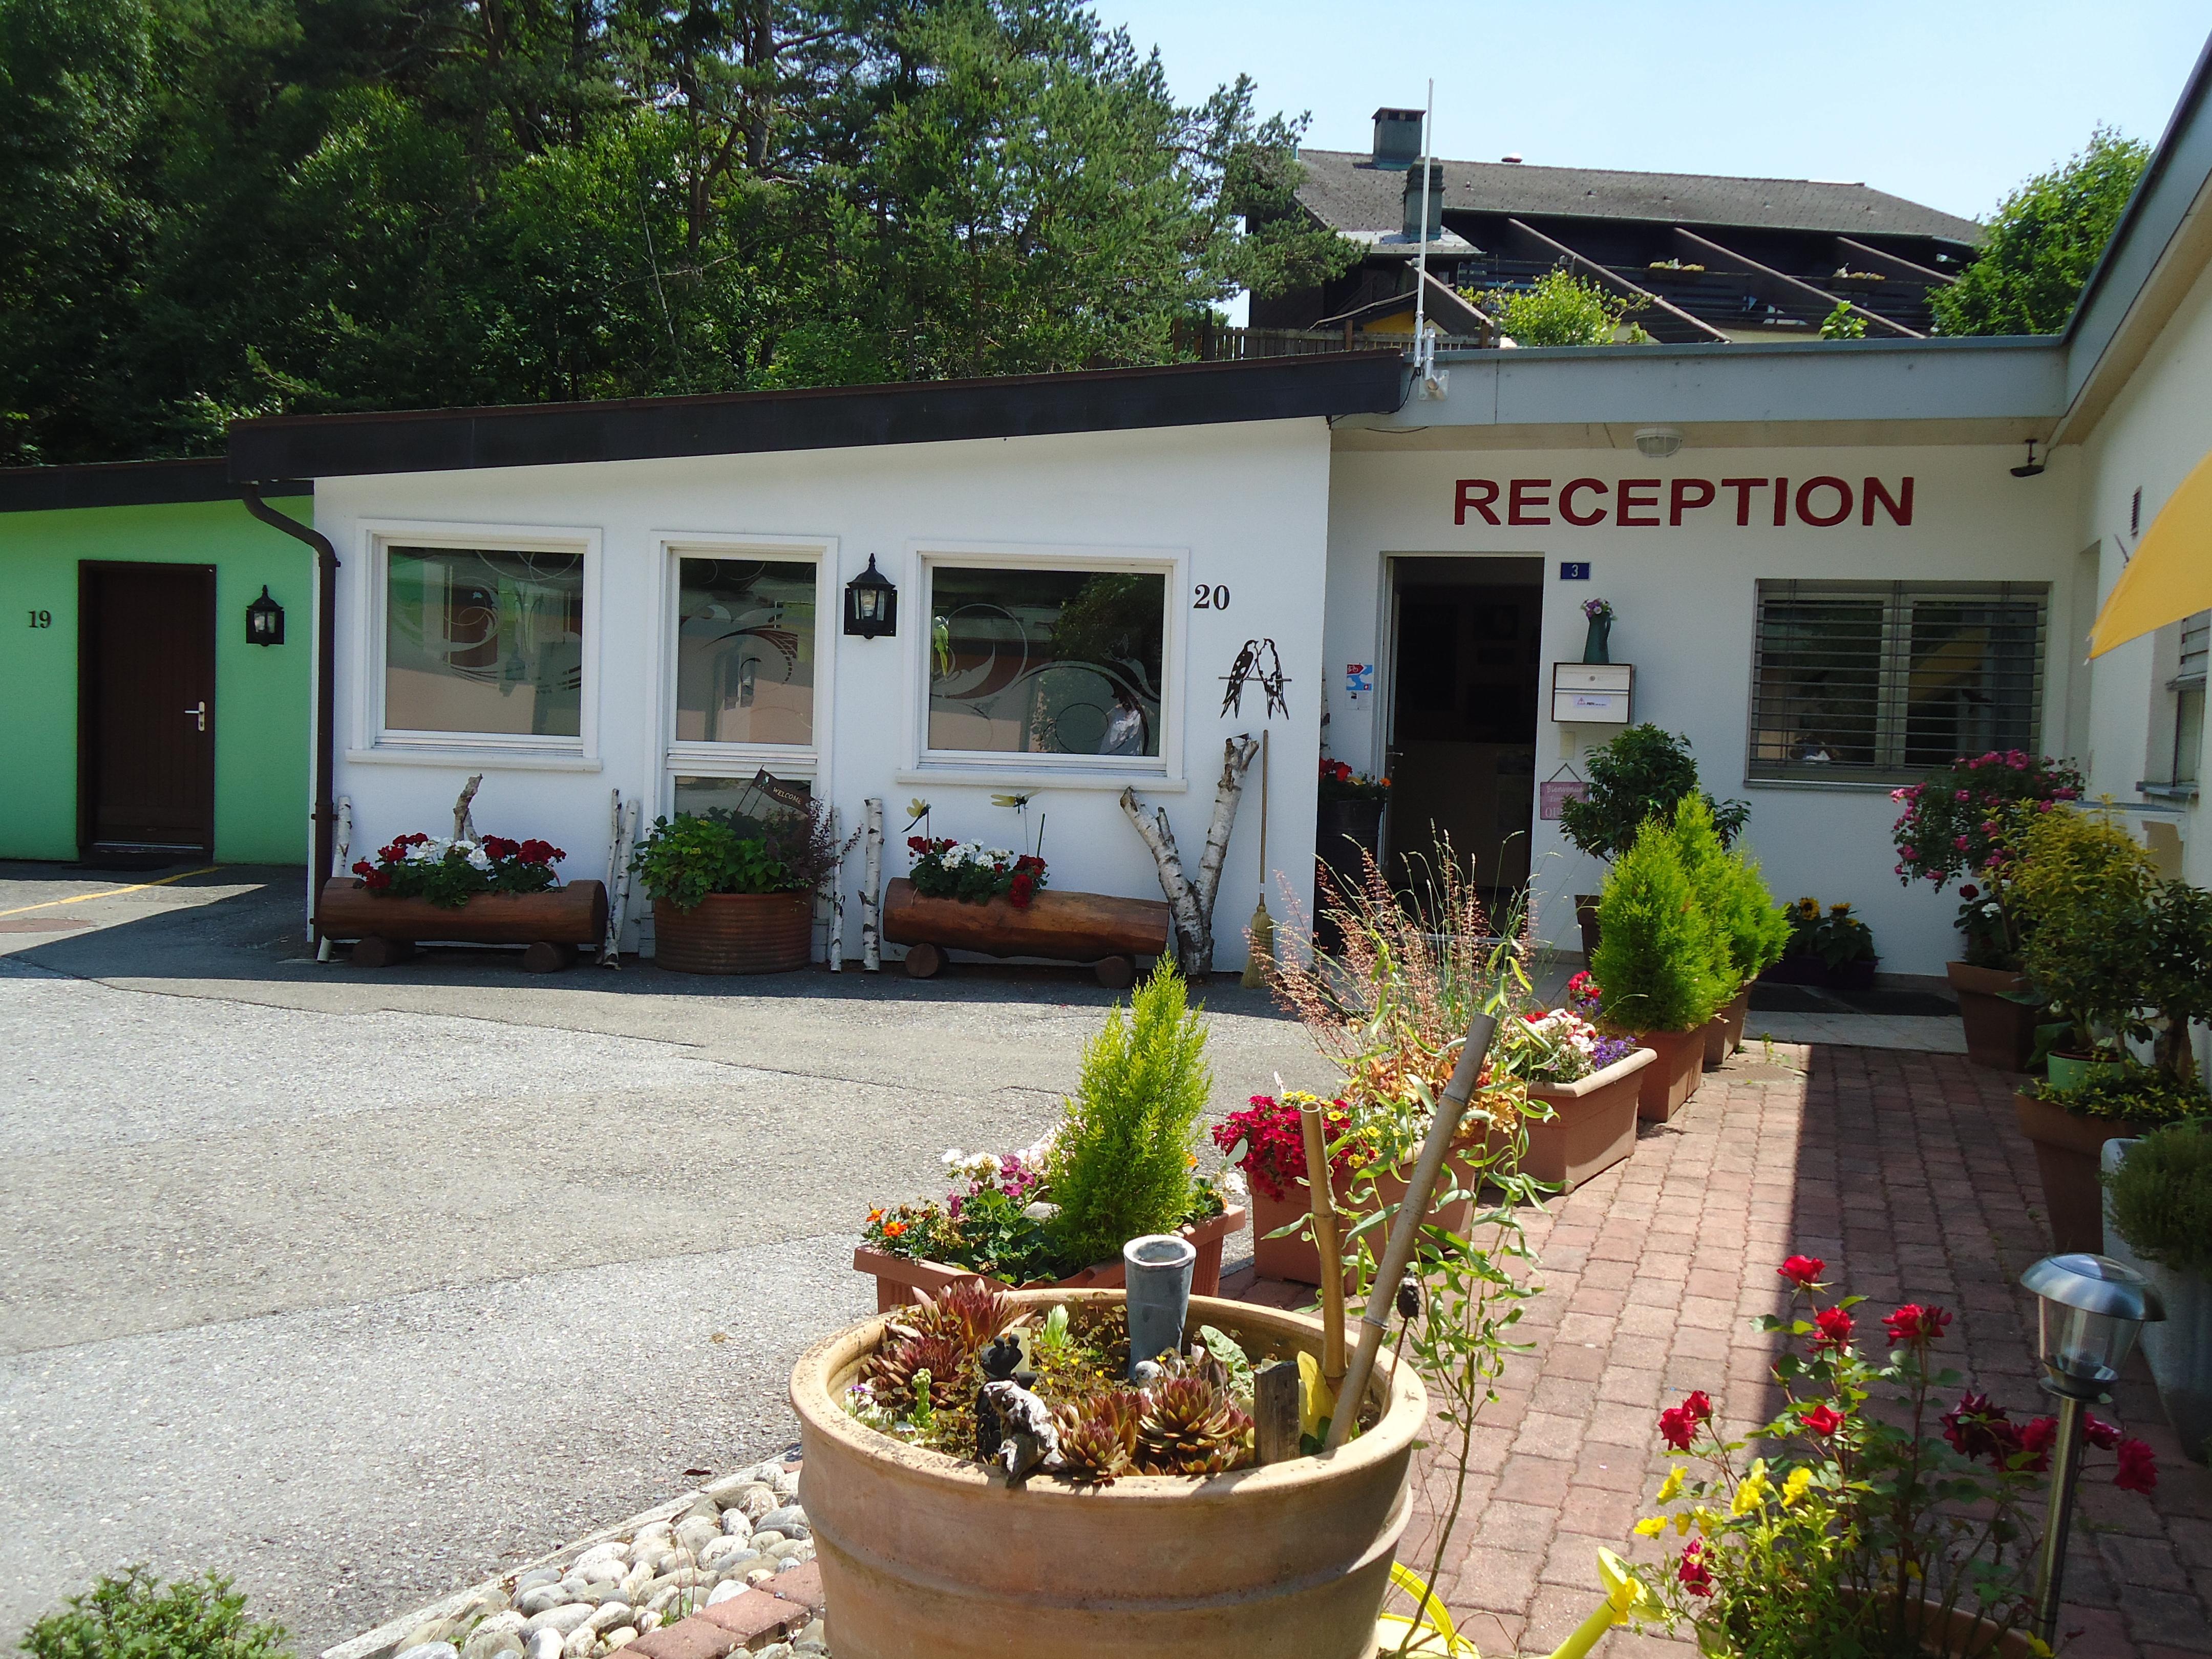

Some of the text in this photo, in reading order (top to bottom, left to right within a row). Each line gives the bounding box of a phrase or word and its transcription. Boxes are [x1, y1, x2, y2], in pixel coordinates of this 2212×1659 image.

[1454, 476, 1914, 526] RECEPTION
[1571, 564, 1578, 577] 3
[1193, 584, 1229, 610] 20
[28, 610, 51, 628] 19
[773, 787, 802, 804] WELCOME
